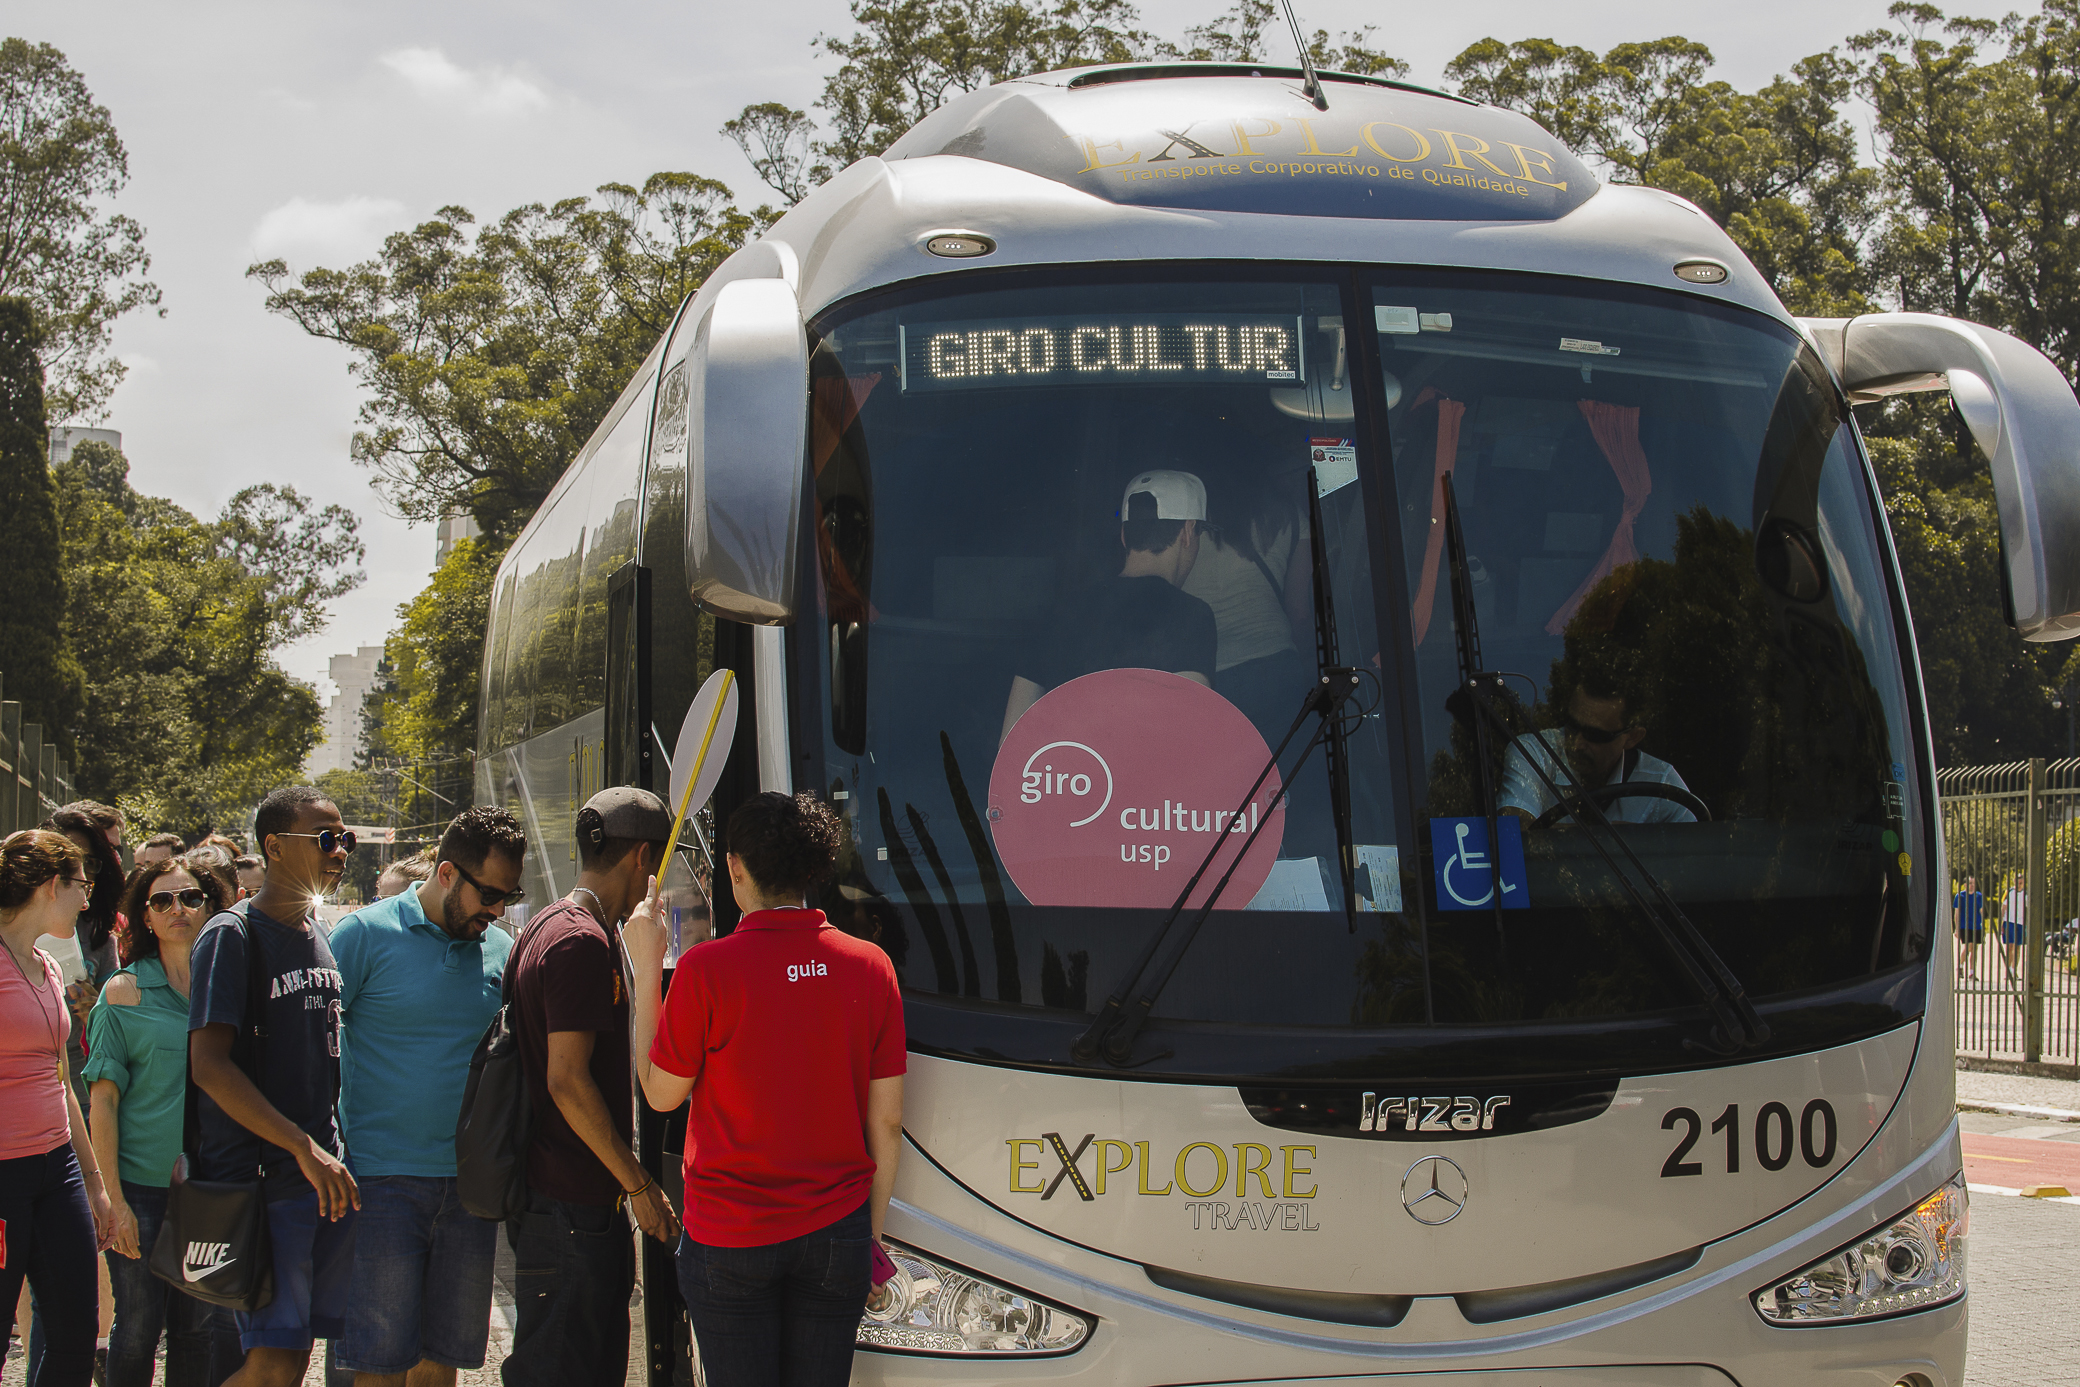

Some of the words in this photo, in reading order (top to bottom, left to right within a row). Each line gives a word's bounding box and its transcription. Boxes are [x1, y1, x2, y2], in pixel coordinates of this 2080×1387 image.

[1063, 117, 1568, 192] EXPLORE
[1117, 161, 1241, 182] Transporte
[1249, 160, 1380, 178] Corporativo
[1388, 163, 1415, 180] de
[1422, 168, 1529, 197] Qualidade
[930, 328, 1054, 378] GIRO
[1073, 325, 1289, 371] CULTUR
[1020, 764, 1092, 804] giro
[1120, 799, 1258, 833] cultural
[1120, 844, 1171, 871] usp
[786, 959, 828, 982] guia
[1659, 1097, 1838, 1178] 2100
[1005, 1132, 1318, 1201] EXPLORE
[1185, 1201, 1320, 1231] TRAVEL
[186, 1241, 231, 1266] NIKE
